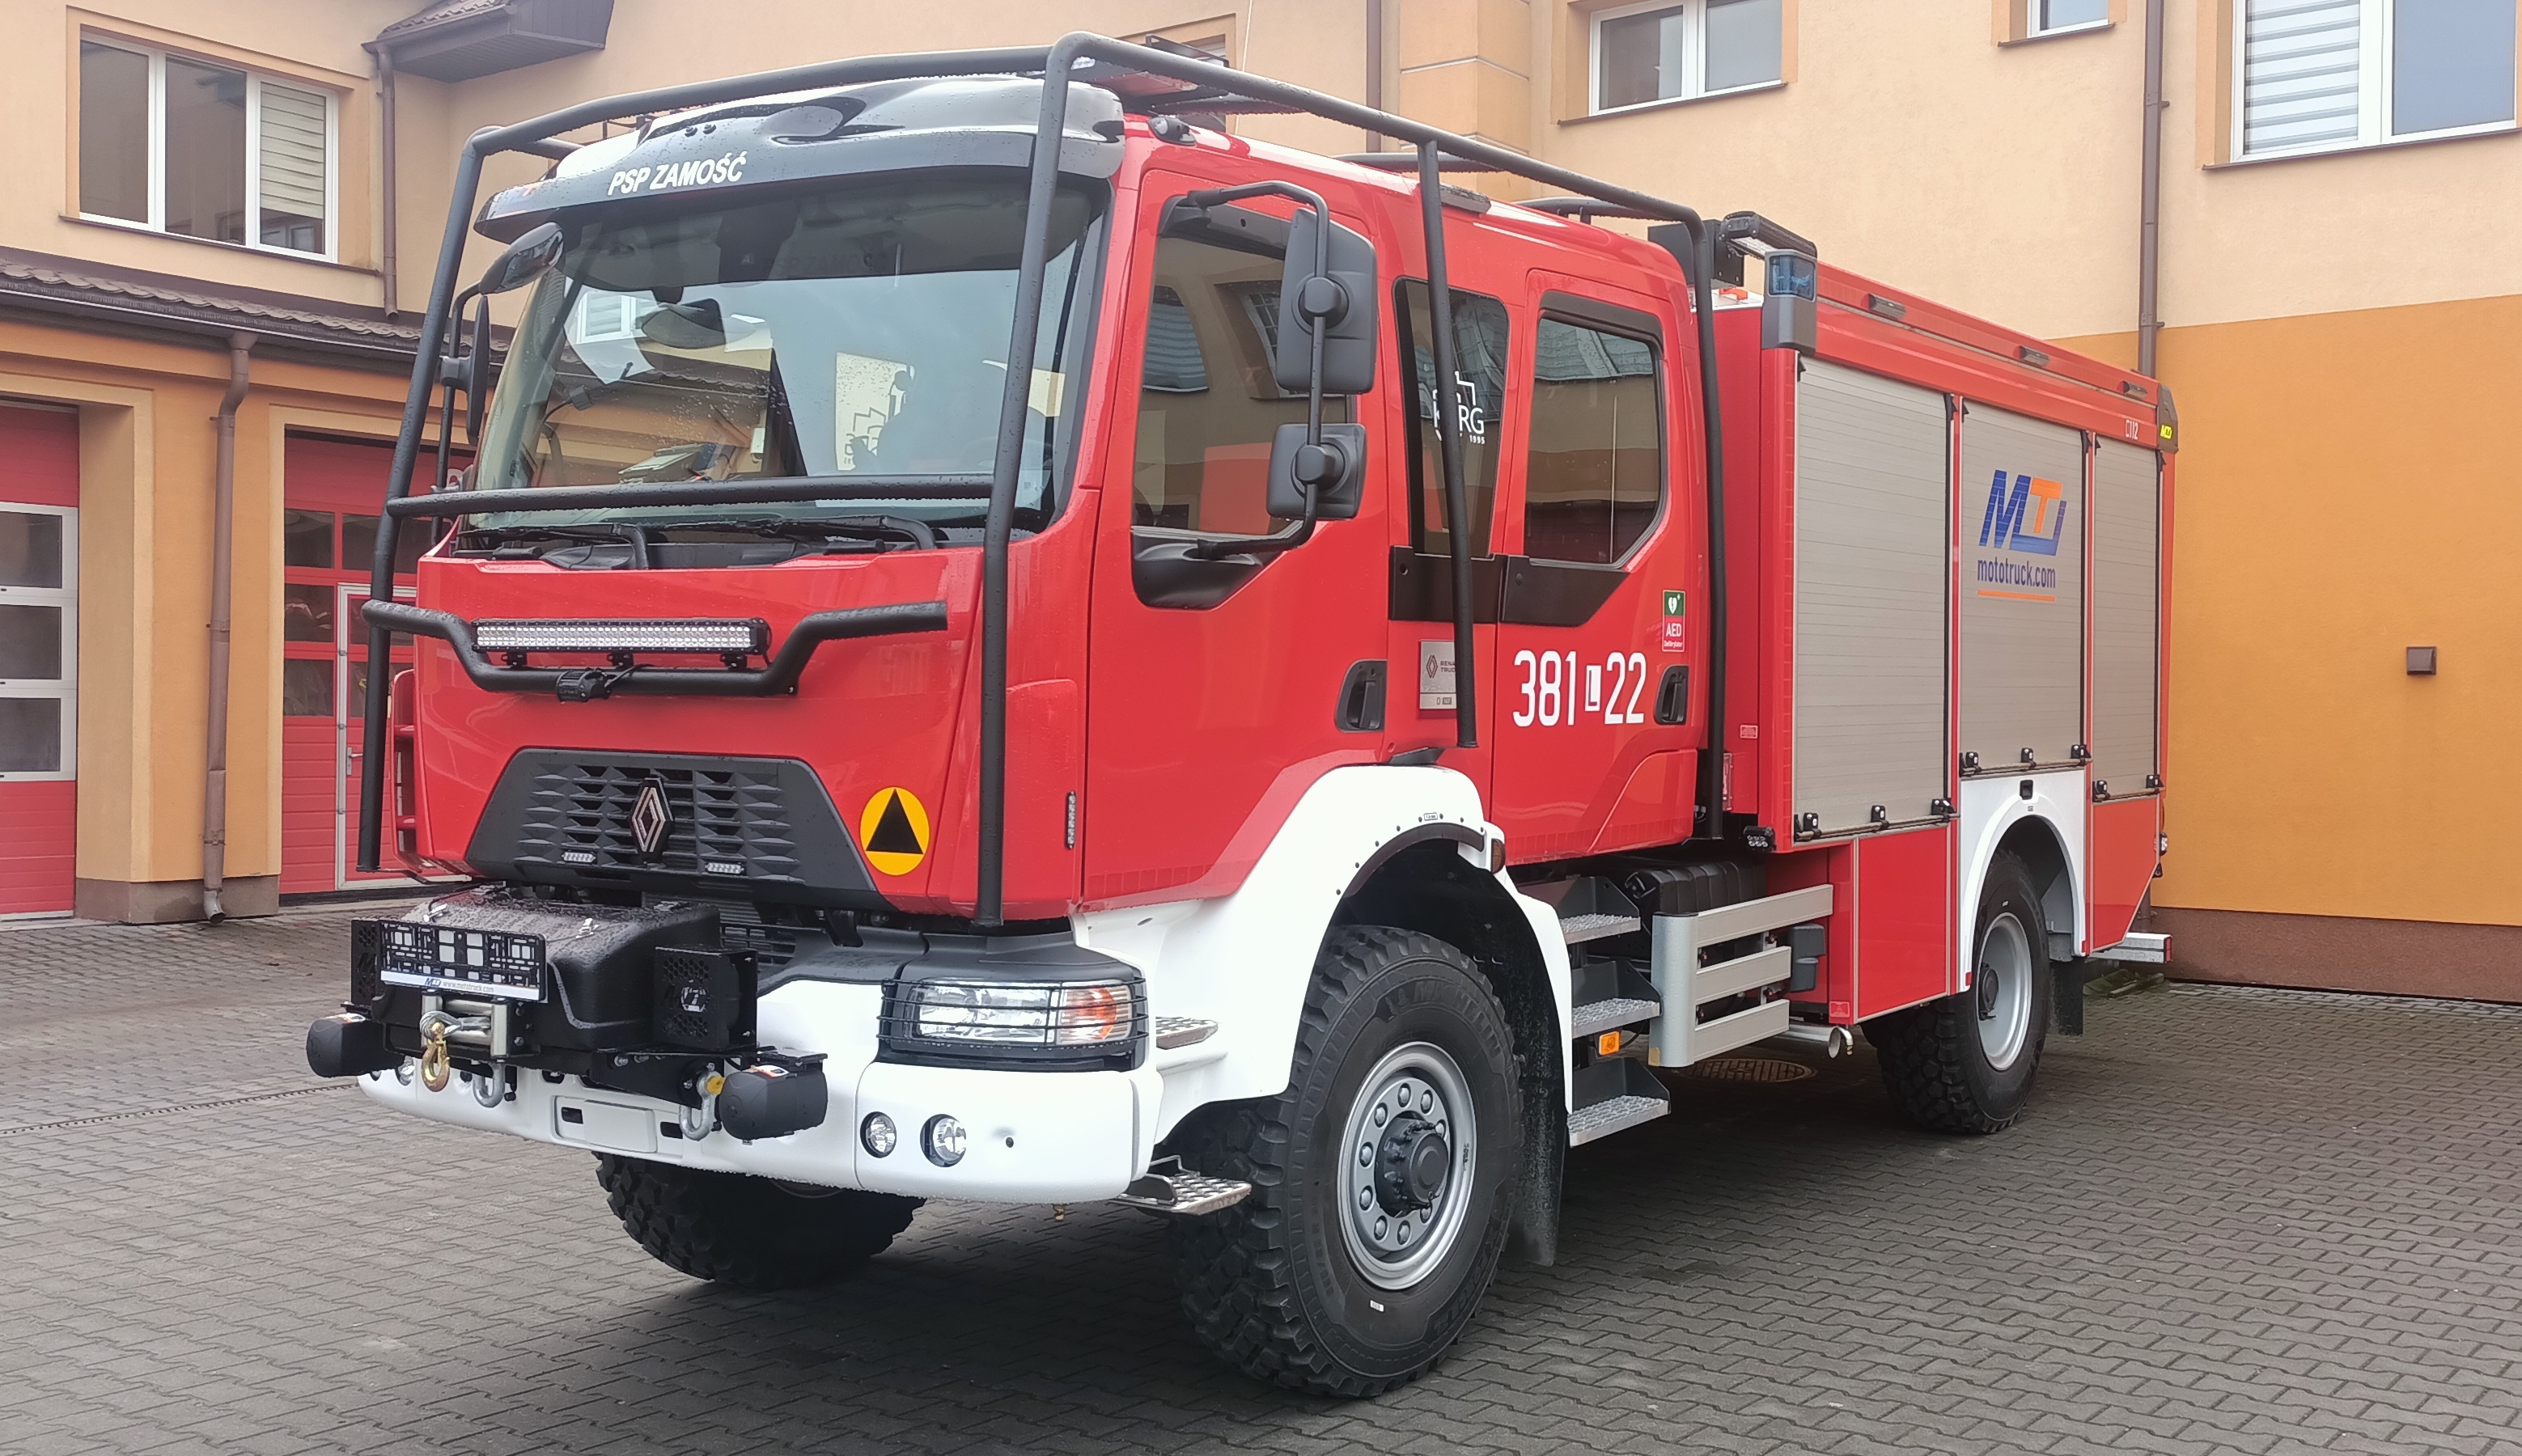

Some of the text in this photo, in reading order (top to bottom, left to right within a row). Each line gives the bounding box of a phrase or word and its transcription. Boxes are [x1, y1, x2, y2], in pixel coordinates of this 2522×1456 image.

[608, 150, 748, 196] PSP ZAMOŚĆ
[1469, 434, 1486, 445] 1995
[1977, 557, 2056, 589] mototruck.com
[1666, 622, 1682, 637] AED
